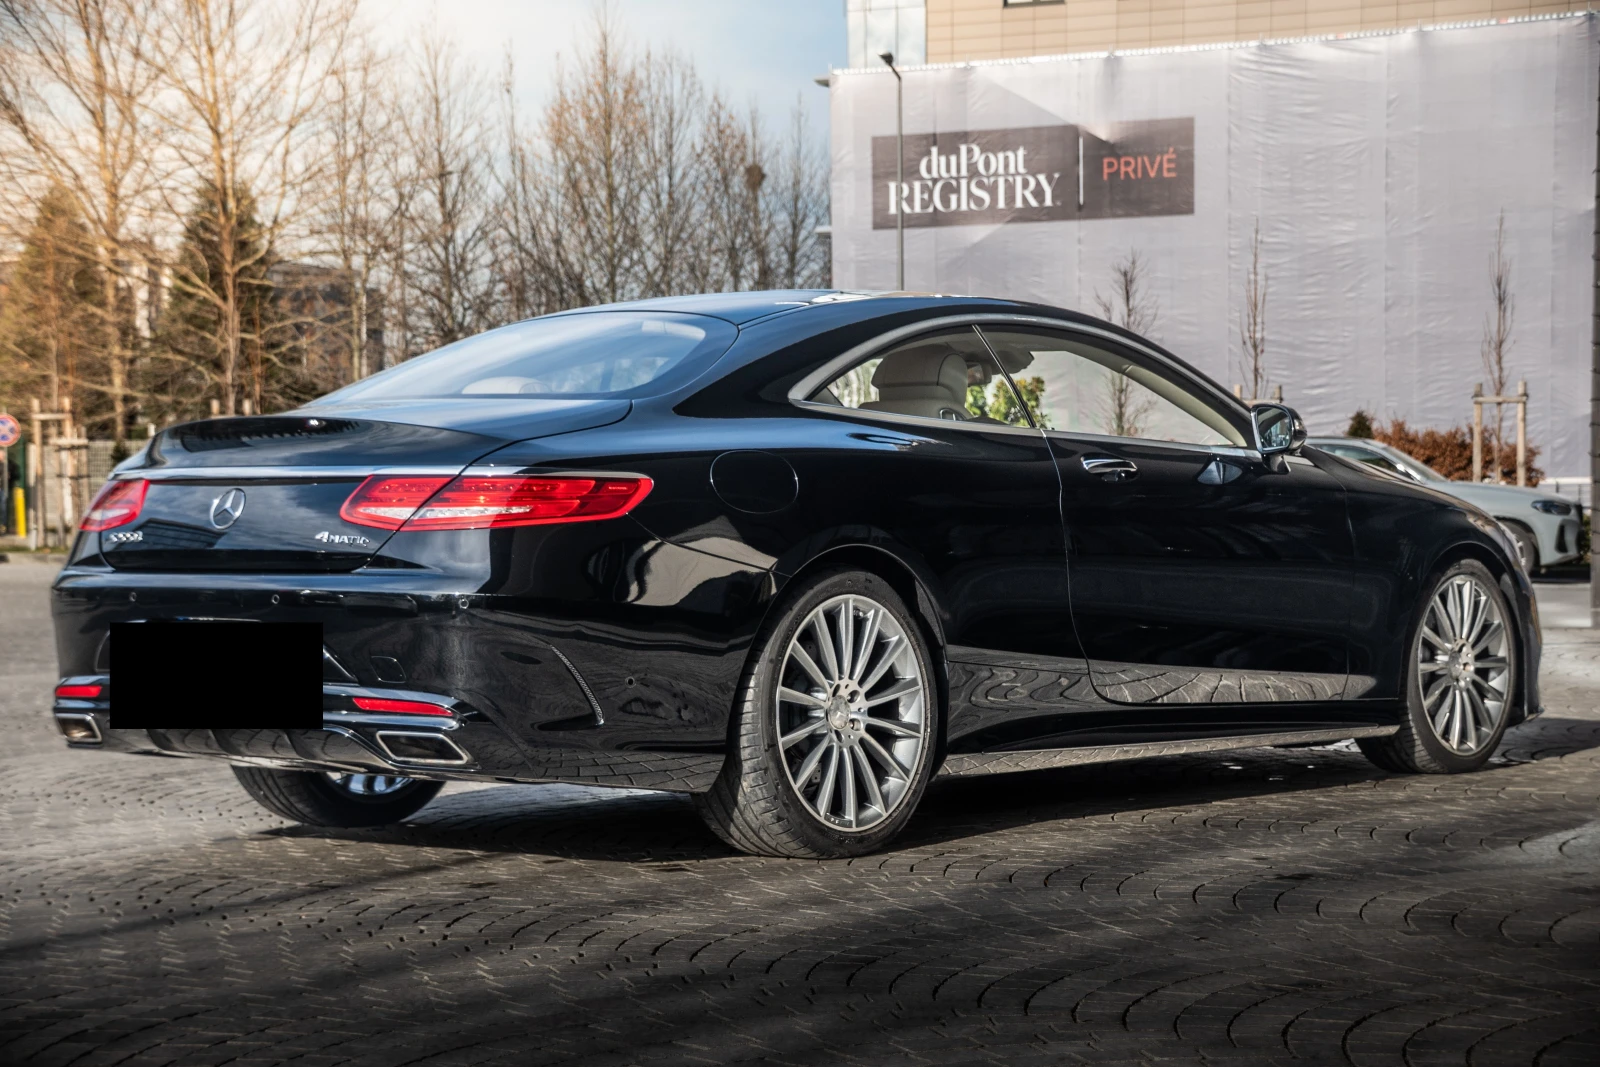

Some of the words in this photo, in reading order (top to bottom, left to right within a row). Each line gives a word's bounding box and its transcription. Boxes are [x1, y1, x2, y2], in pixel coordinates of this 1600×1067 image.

[919, 143, 1026, 179] duPont
[1102, 147, 1177, 180] PRIVÉ
[888, 172, 1060, 215] REGISTRY
[315, 531, 370, 547] 4MATIC
